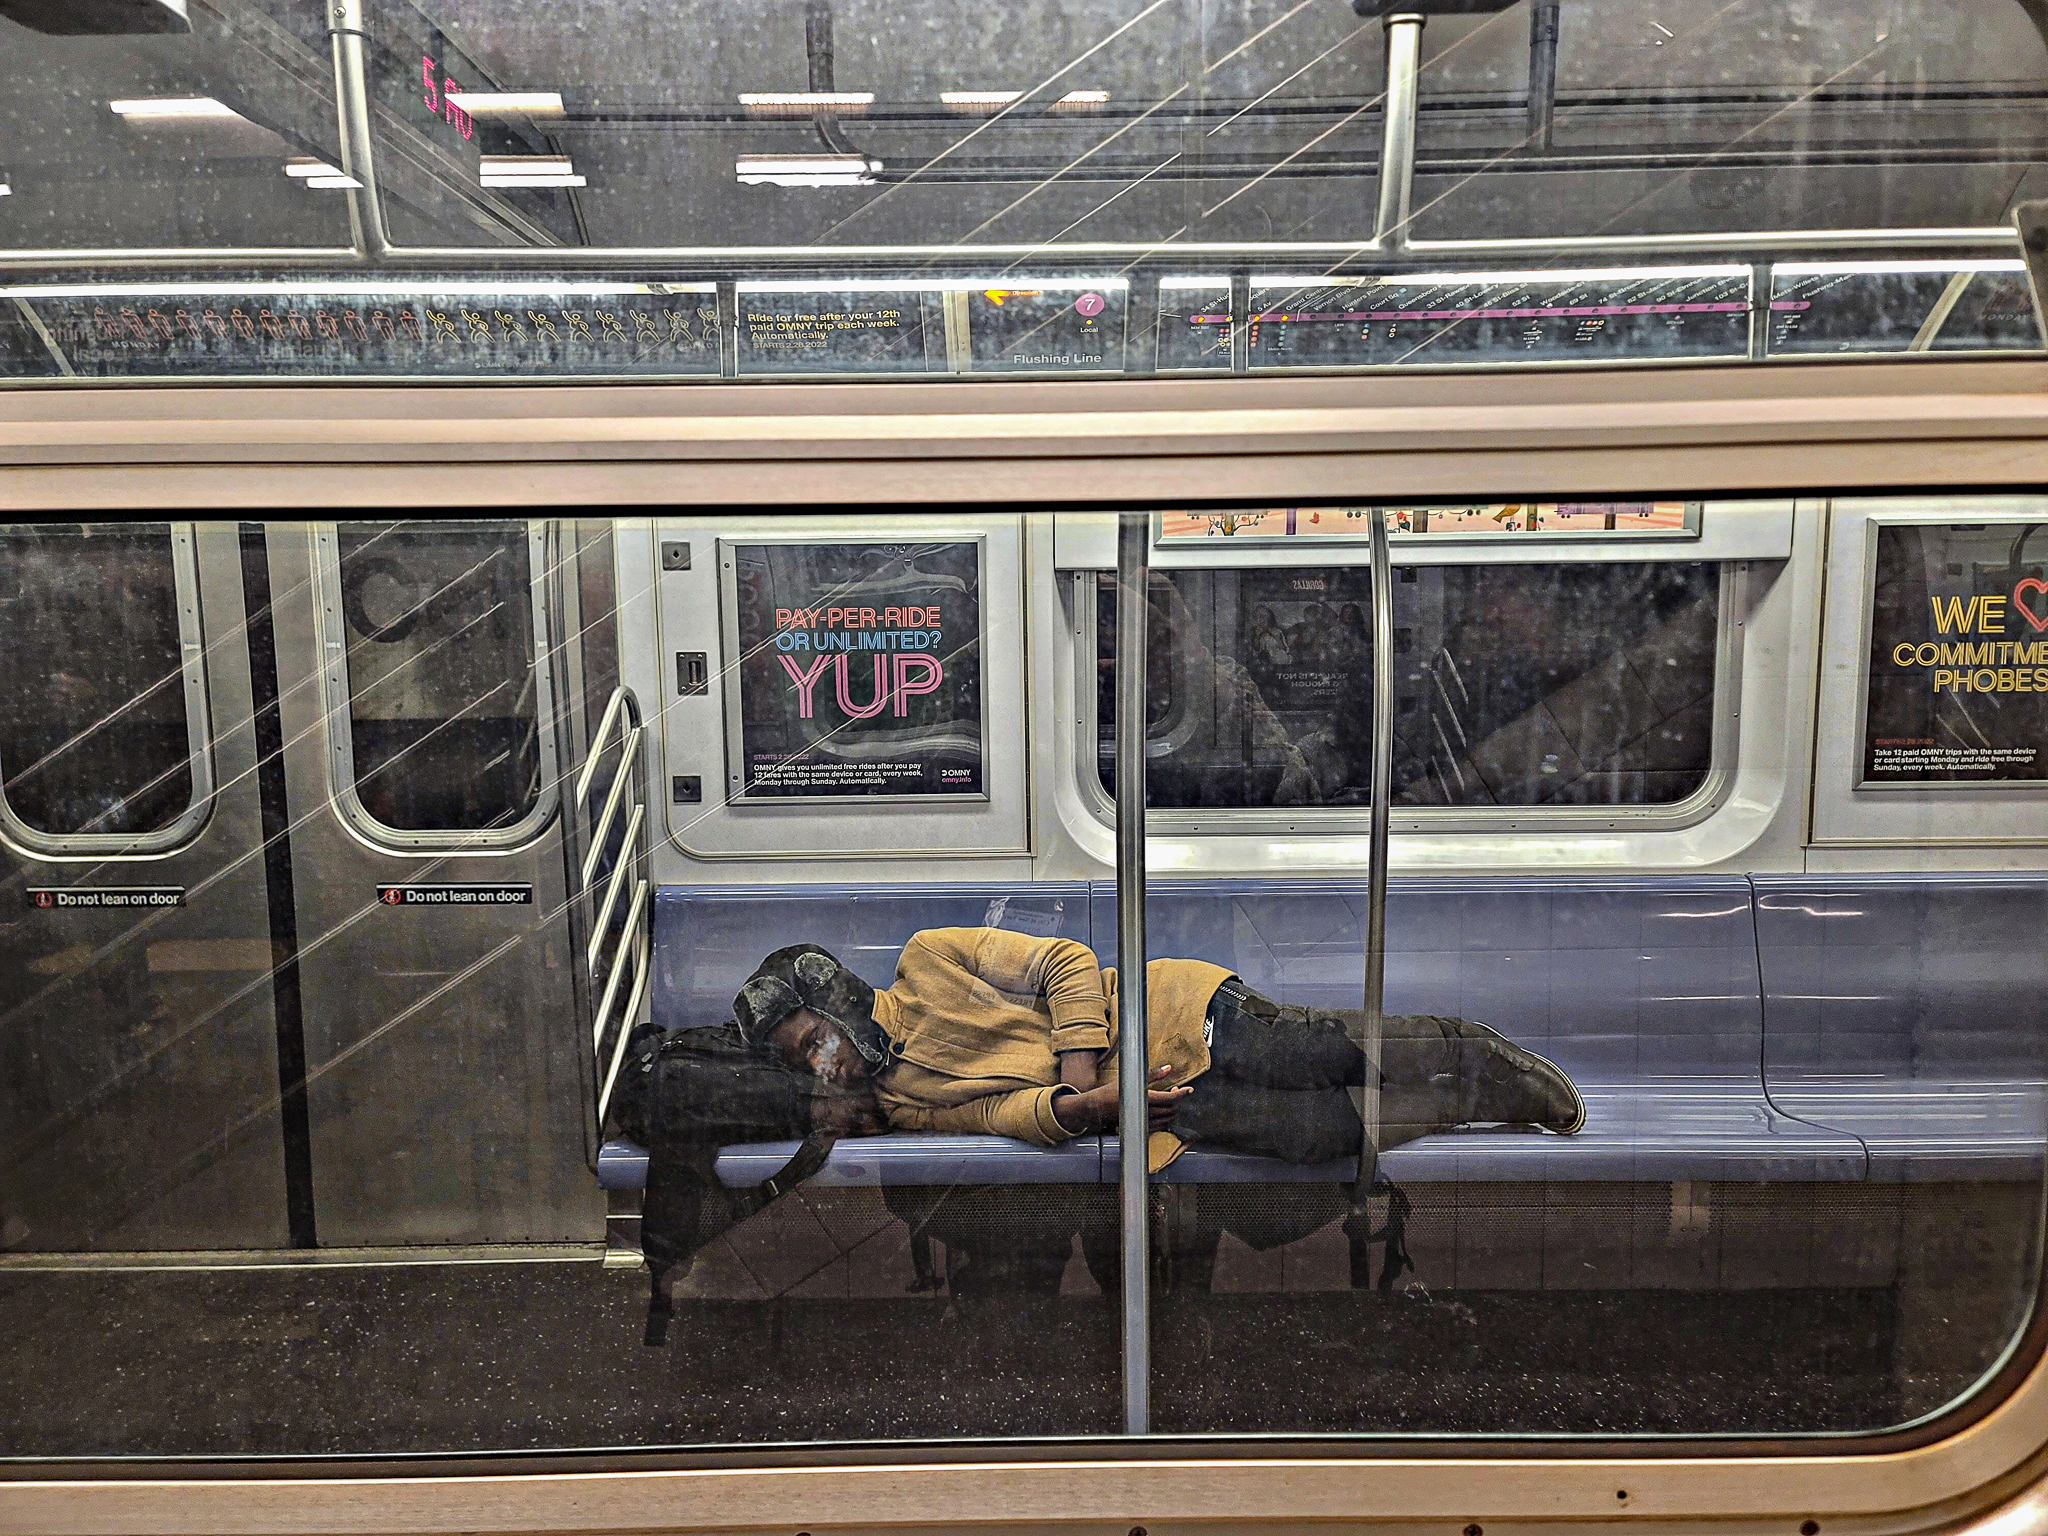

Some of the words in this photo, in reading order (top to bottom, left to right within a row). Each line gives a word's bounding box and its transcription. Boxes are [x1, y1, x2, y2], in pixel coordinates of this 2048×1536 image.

[1342, 294, 1367, 310] Hunters
[1366, 284, 1385, 296] Point
[1398, 286, 1438, 310] Queensboro
[1521, 294, 1531, 302] St
[1686, 284, 1717, 302] Junction
[1714, 291, 1728, 300] 103
[1084, 298, 1096, 311] 7
[1201, 305, 1210, 313] 34
[1285, 297, 1305, 311] Grand
[1370, 297, 1388, 310] Court
[1426, 301, 1436, 309] 33
[748, 313, 773, 322] Ride
[775, 313, 792, 322] for
[794, 313, 817, 321] free
[820, 312, 845, 321] after
[848, 312, 873, 321] your
[876, 309, 901, 318] 12th
[749, 322, 774, 332] paid
[776, 322, 812, 331] OMNY
[815, 321, 834, 331] trip
[837, 320, 865, 329] each
[867, 318, 900, 328] week.
[751, 331, 829, 340] Automatically.
[1013, 354, 1070, 365] Flushing
[1073, 353, 1102, 363] Line
[775, 606, 942, 629] PAY-PER-RIDE
[1931, 595, 2007, 634] WE
[775, 632, 810, 651] OR
[814, 631, 942, 651] UNLIMITED?
[1893, 642, 2048, 667] COMMITME
[777, 653, 943, 719] YUP
[1933, 668, 2048, 693] PHOBES
[1903, 748, 1919, 756] paid
[1945, 748, 1962, 756] trips
[2013, 747, 2036, 755] device
[1901, 756, 1929, 764] starting
[1930, 756, 1959, 764] Monday
[2006, 755, 2034, 763] through
[947, 769, 971, 777] OMNY
[1947, 763, 1996, 771] Automatically.
[783, 778, 810, 786] through
[811, 778, 838, 786] Sunday.
[57, 893, 76, 906] Do
[78, 894, 99, 905] not
[101, 893, 129, 905] lean
[131, 895, 147, 905] on
[149, 892, 180, 905] door
[406, 890, 425, 902] Do
[427, 891, 447, 902] not
[450, 890, 476, 902] lean
[478, 892, 494, 902] on
[496, 890, 526, 901] door
